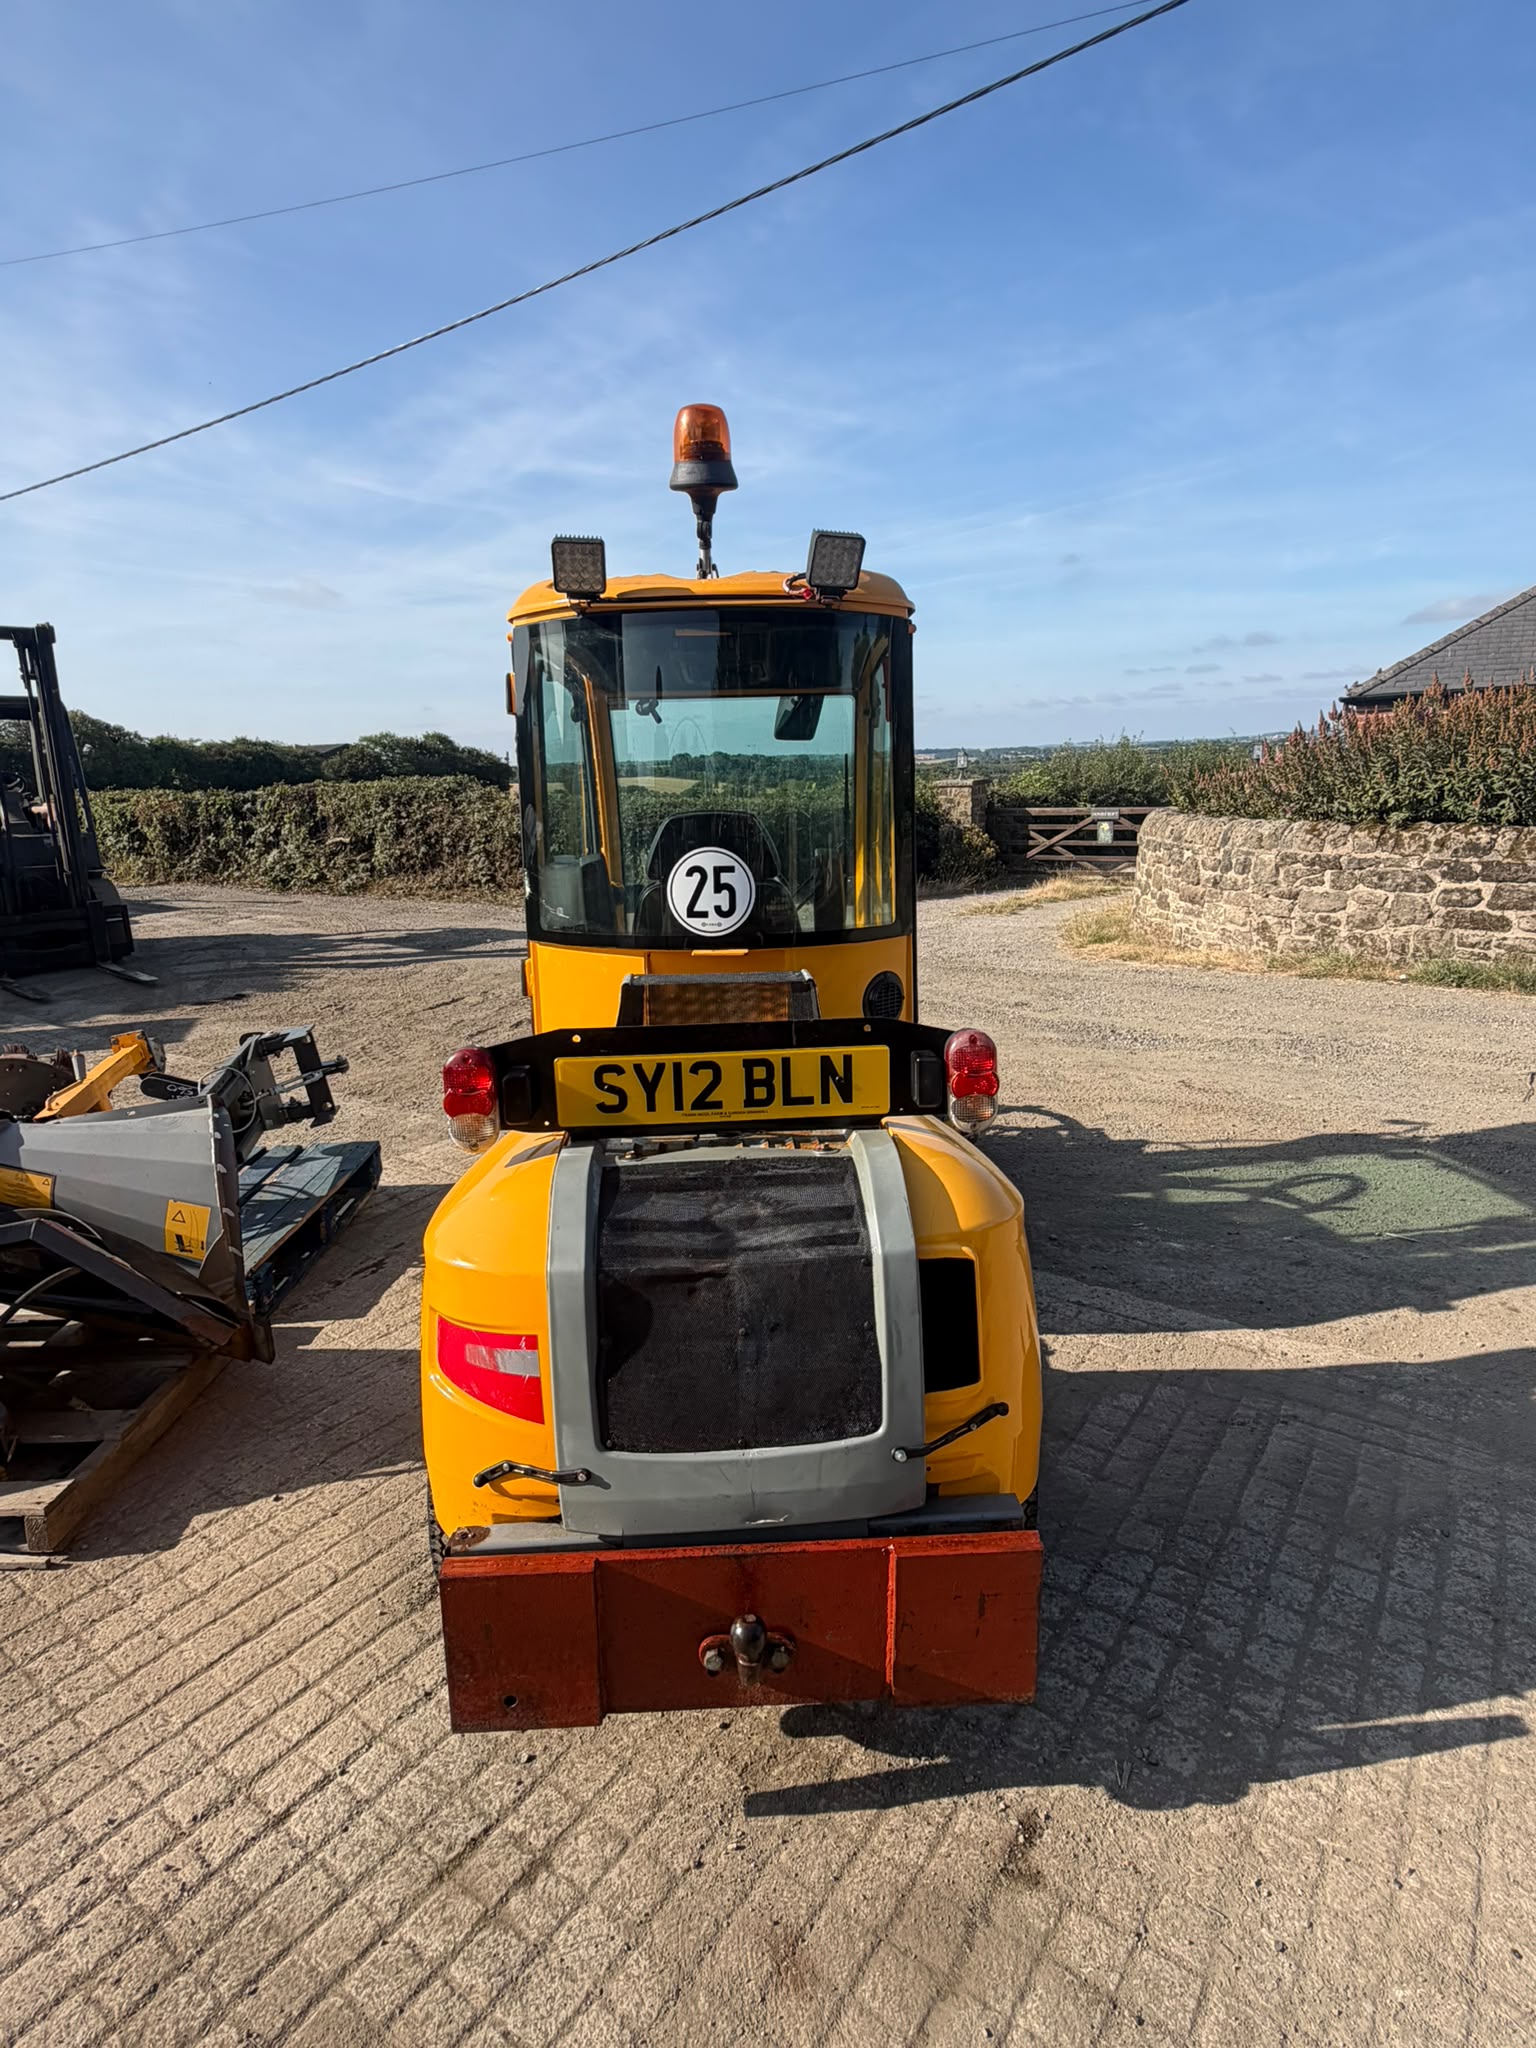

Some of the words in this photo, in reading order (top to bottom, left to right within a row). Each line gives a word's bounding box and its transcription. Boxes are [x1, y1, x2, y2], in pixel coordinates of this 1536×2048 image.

[685, 865, 737, 919] 25
[593, 1059, 723, 1114] SY12
[742, 1054, 853, 1109] BLN
